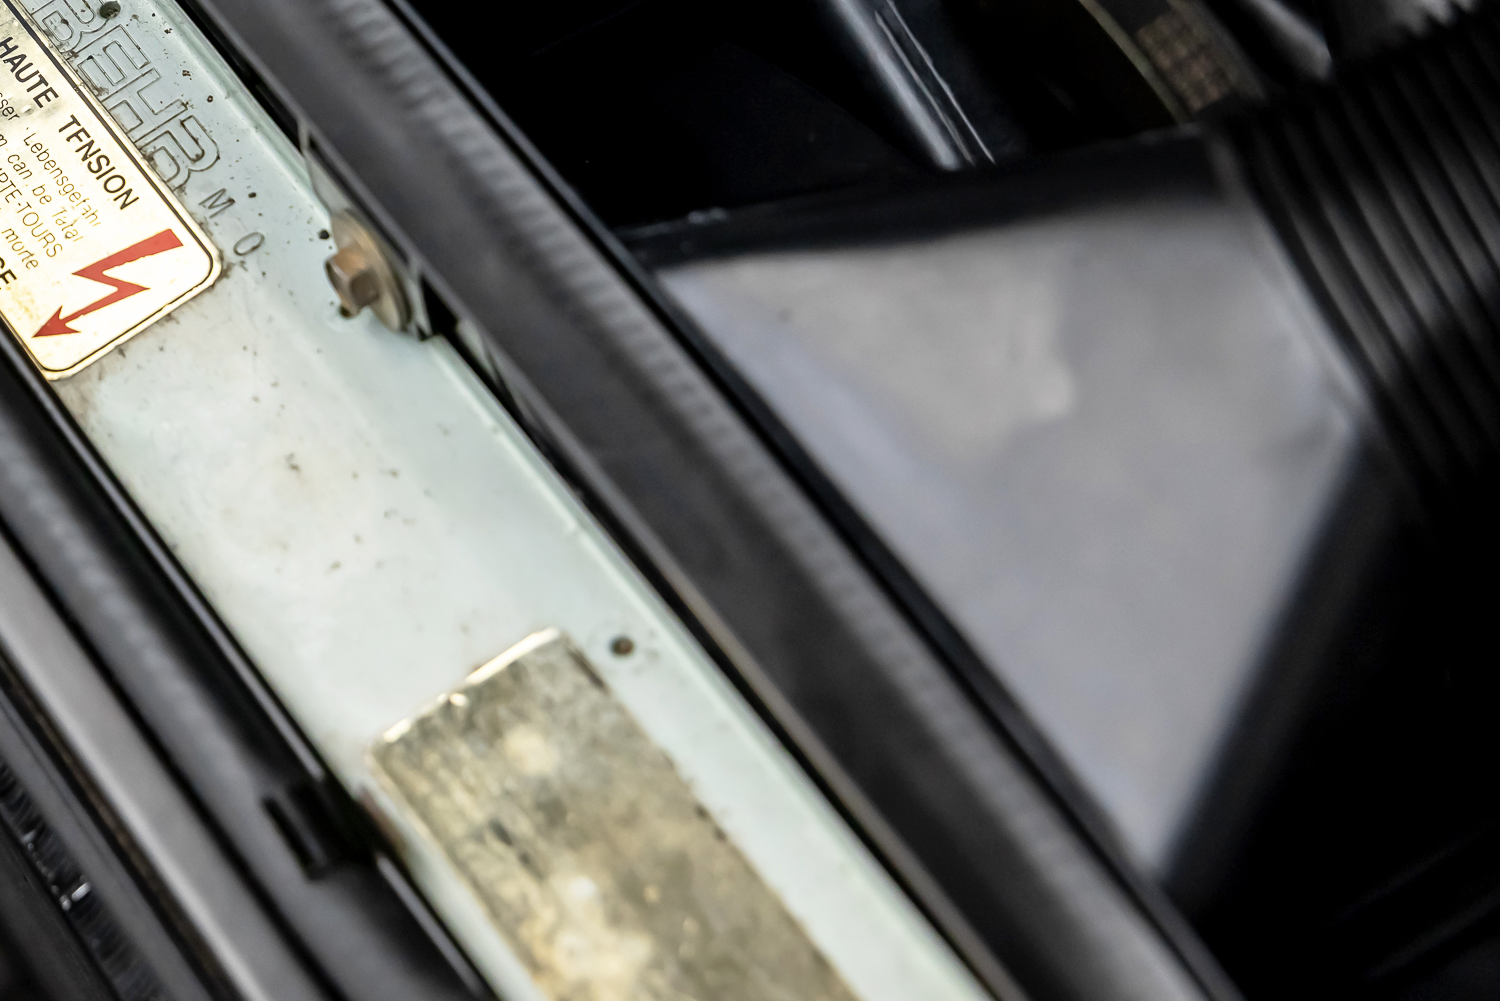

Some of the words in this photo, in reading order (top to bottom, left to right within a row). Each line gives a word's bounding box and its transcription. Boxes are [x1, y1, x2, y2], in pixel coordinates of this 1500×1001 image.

[5, 152, 35, 182] can
[30, 183, 56, 207] be
[18, 132, 106, 232] Lebensgefahr
[54, 115, 140, 212] TENSION
[0, 226, 42, 272] morte
